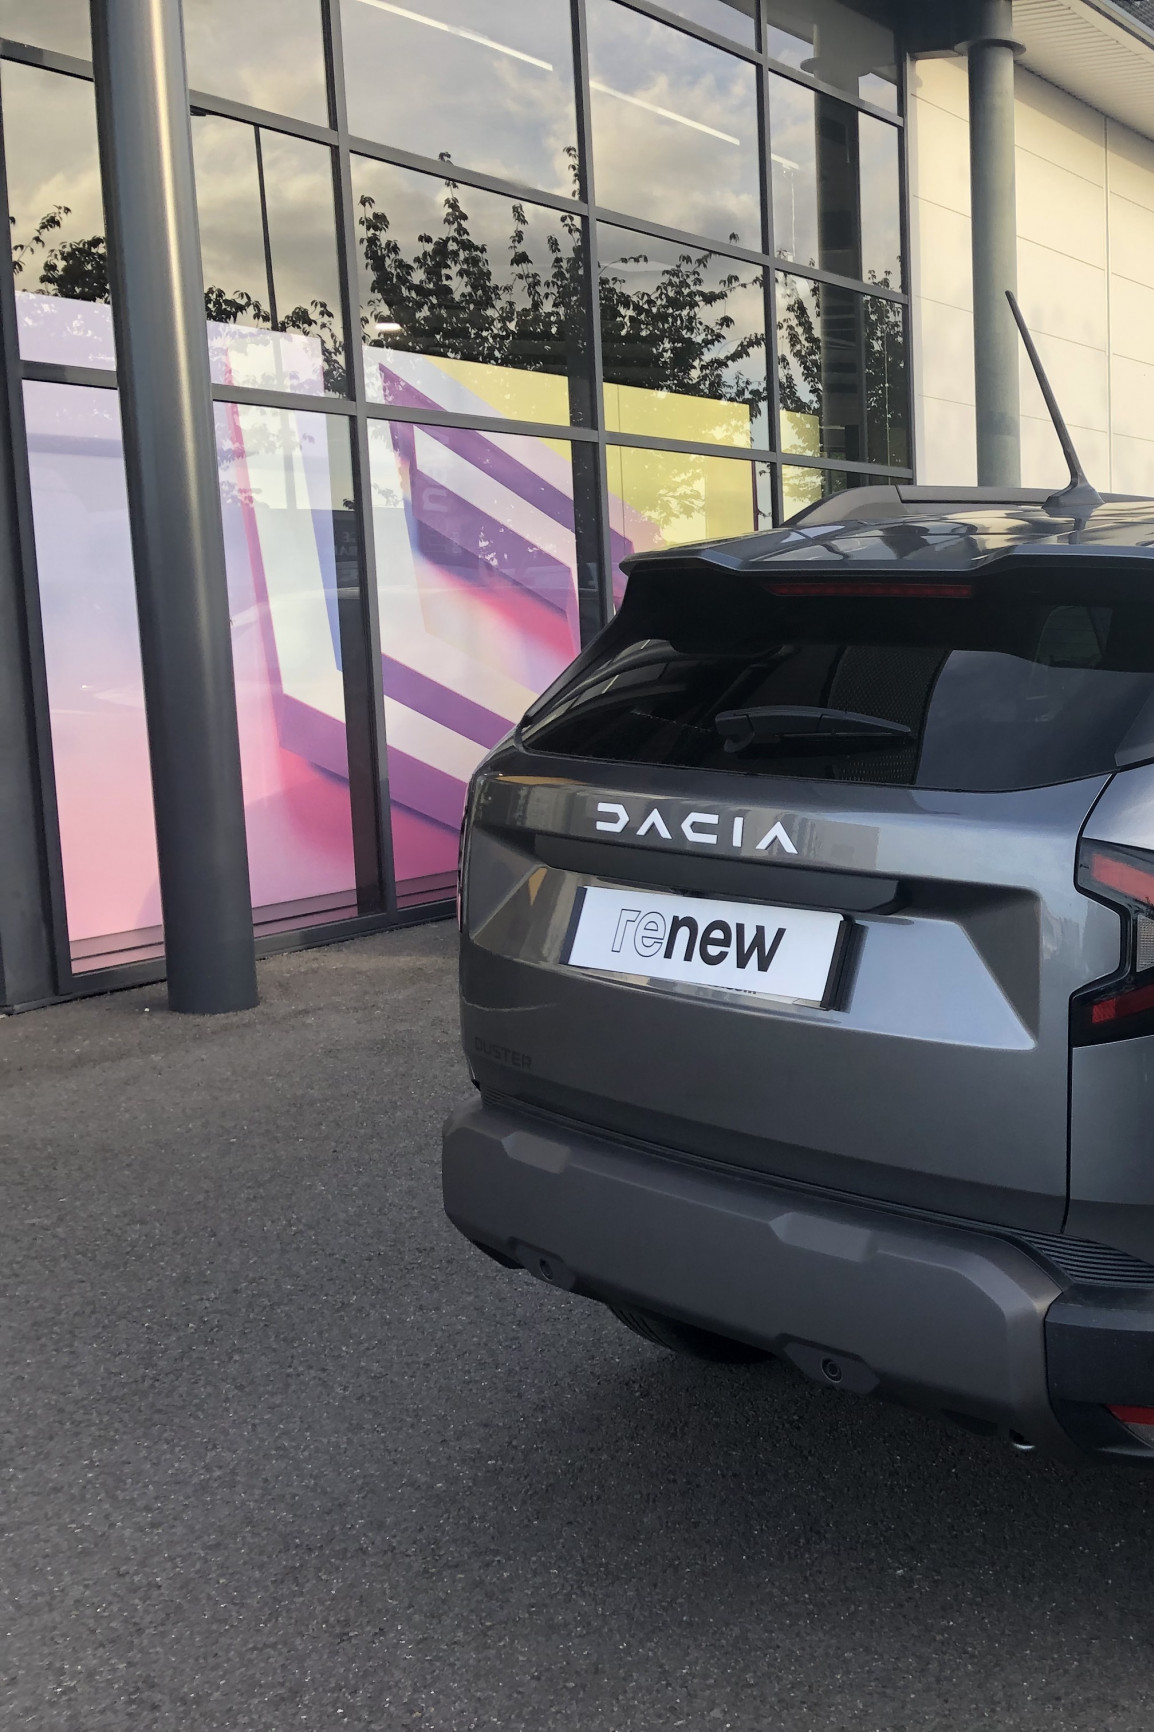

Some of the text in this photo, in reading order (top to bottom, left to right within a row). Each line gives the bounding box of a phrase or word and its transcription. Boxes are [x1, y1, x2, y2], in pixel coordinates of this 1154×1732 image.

[595, 802, 798, 854] DACIA
[611, 908, 786, 972] renew
[474, 1036, 532, 1070] DUSTER
